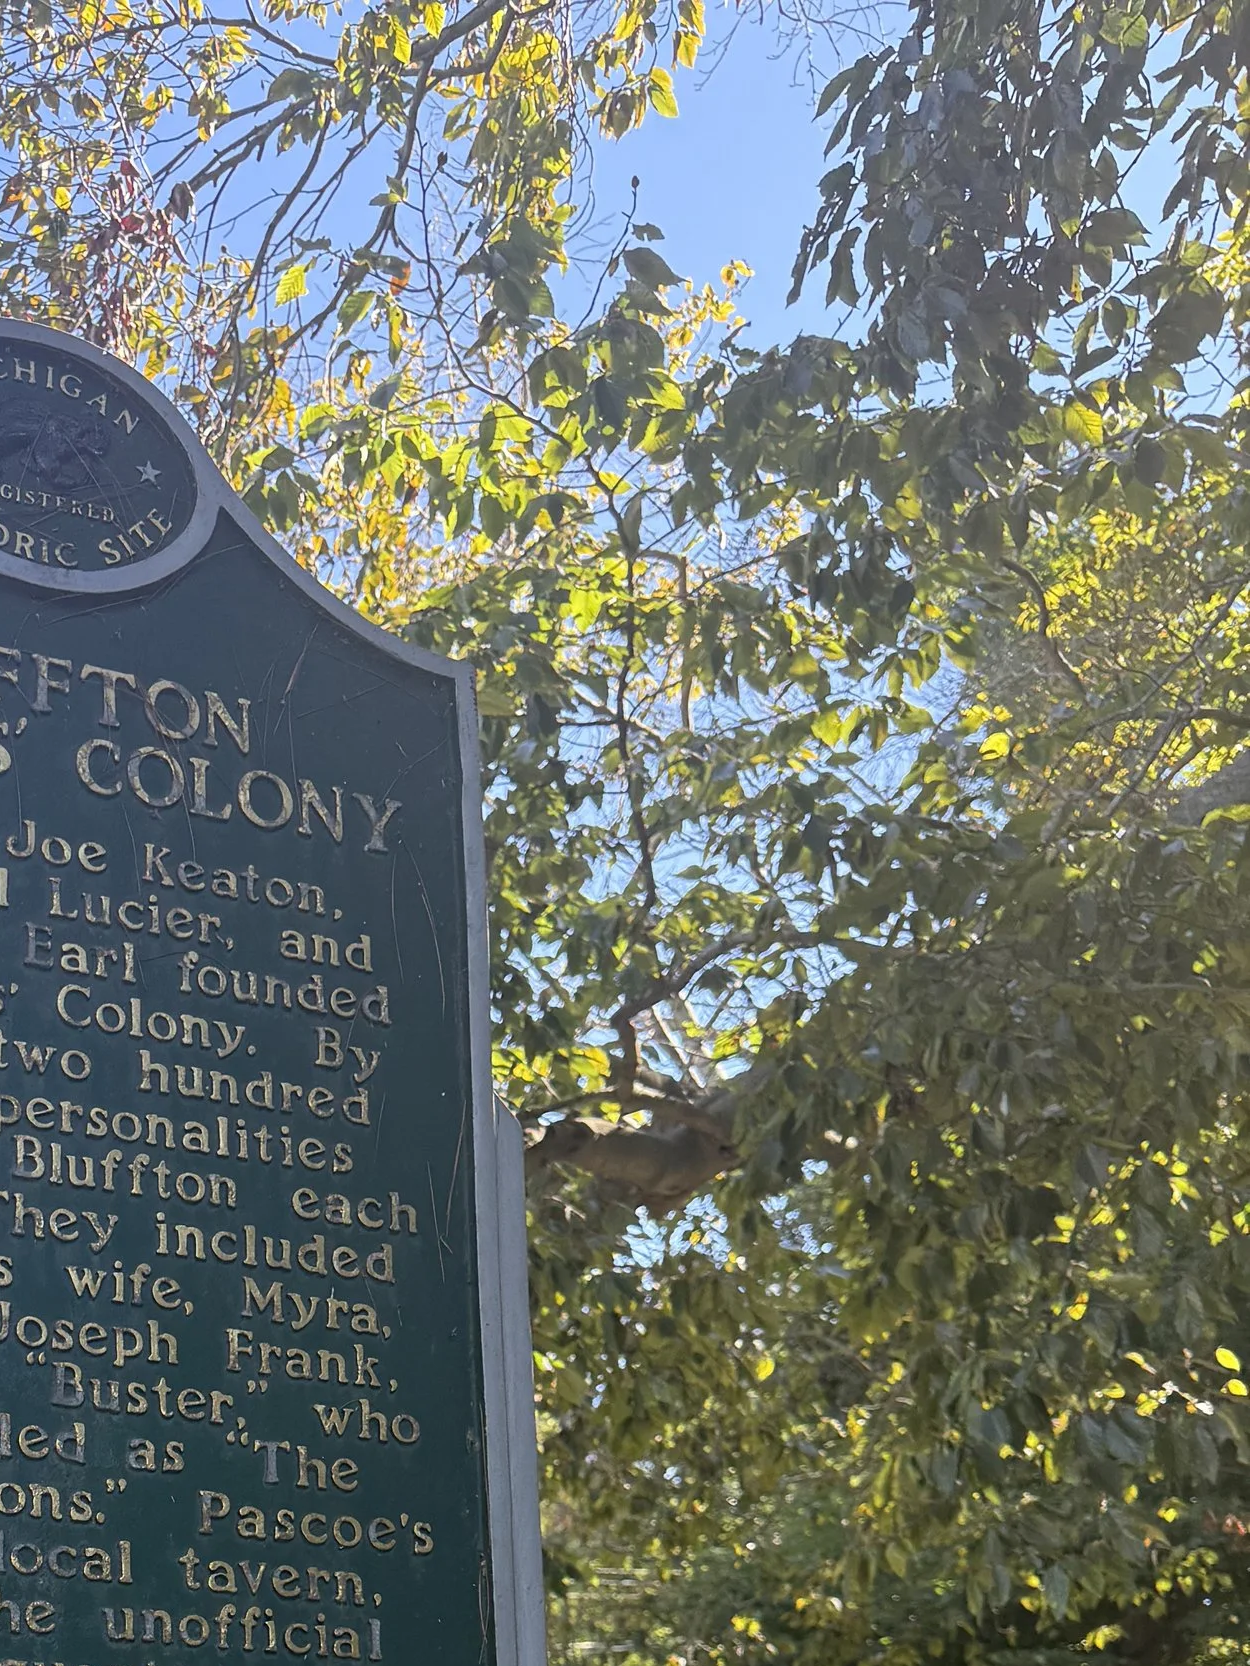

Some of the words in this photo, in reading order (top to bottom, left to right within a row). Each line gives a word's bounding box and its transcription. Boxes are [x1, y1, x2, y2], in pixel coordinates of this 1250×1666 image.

[99, 508, 172, 564] SITE
[76, 739, 402, 853] COLONY
[6, 820, 107, 872] Joe
[143, 843, 342, 920] Keaton,
[49, 877, 234, 950] Lucier,
[280, 929, 372, 972] and
[24, 921, 136, 983] Earl
[179, 951, 391, 1025] founded
[56, 984, 256, 1058] Colony.
[315, 1027, 380, 1083] By
[138, 1049, 370, 1125] hundred
[13, 1134, 236, 1207] Bluffton
[292, 1187, 417, 1234] each
[155, 1212, 395, 1283] included
[66, 1260, 193, 1316] wife,
[242, 1276, 391, 1339] Myra,
[226, 1327, 398, 1392] Frank,
[128, 1437, 185, 1472] as
[313, 1399, 420, 1443] who
[199, 1490, 434, 1555] Pascoe's
[179, 1547, 383, 1607] tavern,
[102, 1604, 383, 1660] unofficial
